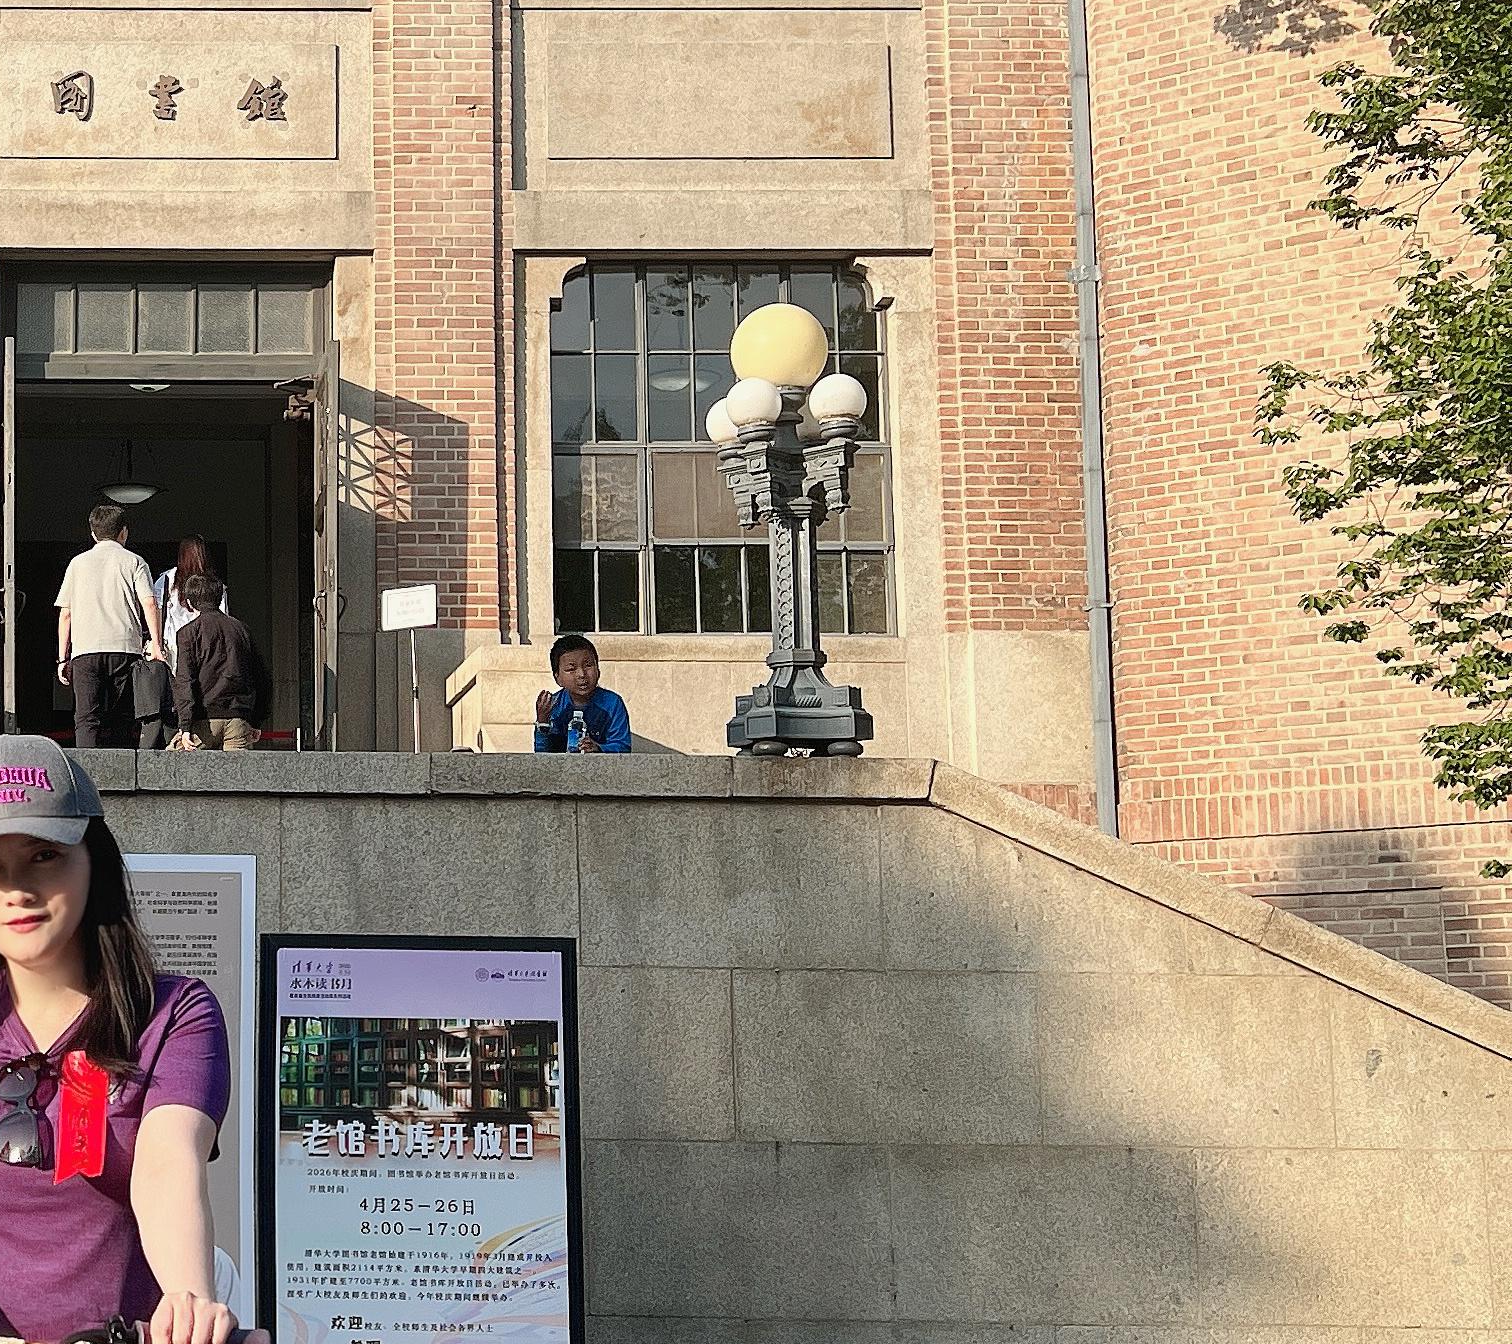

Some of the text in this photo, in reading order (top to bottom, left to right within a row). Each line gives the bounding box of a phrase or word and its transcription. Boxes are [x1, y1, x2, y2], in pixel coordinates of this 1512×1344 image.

[302, 1119, 535, 1160] 老馆书库开放日
